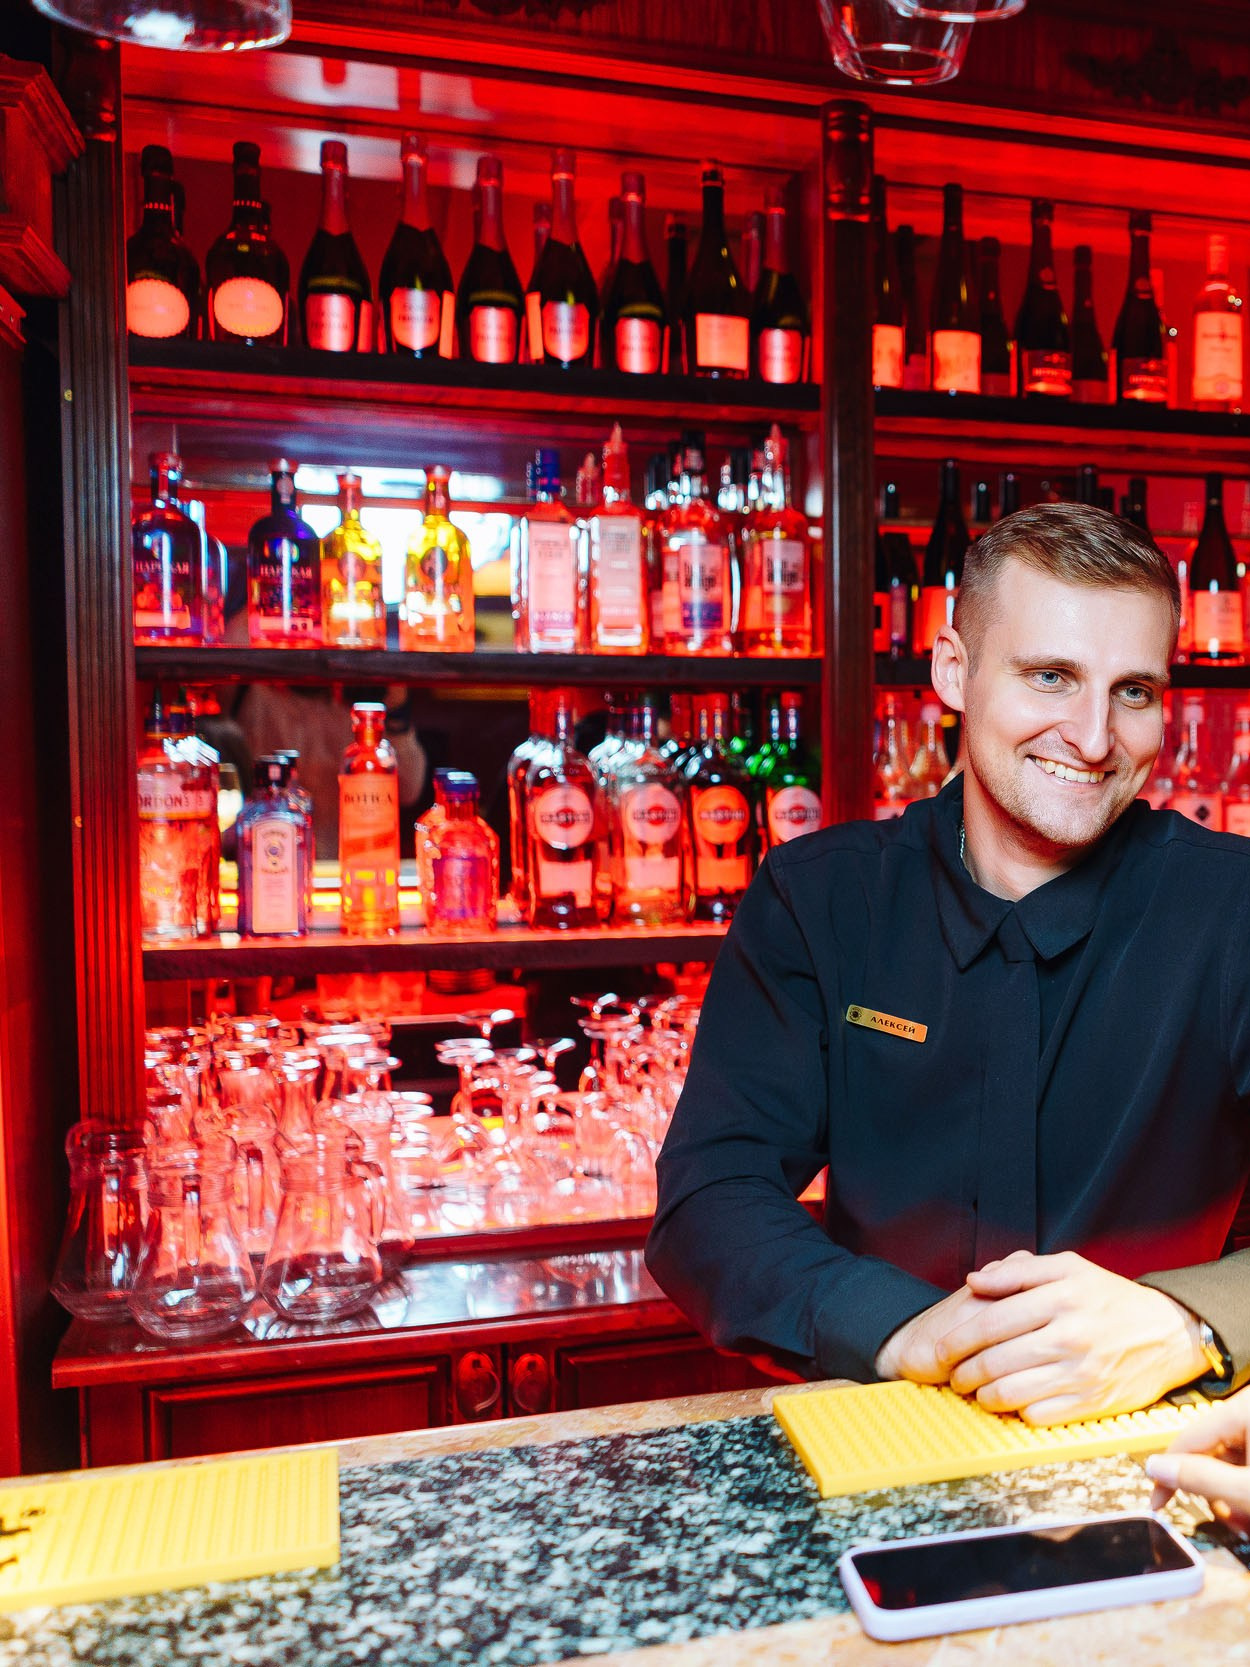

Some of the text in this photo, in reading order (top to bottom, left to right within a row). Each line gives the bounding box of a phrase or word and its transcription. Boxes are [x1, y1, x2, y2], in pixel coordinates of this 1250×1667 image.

[135, 560, 190, 575] ЦАРАЯ
[260, 565, 313, 579] ЦАРКАЯ
[870, 1016, 916, 1034] АЛЕКСЕЙ
